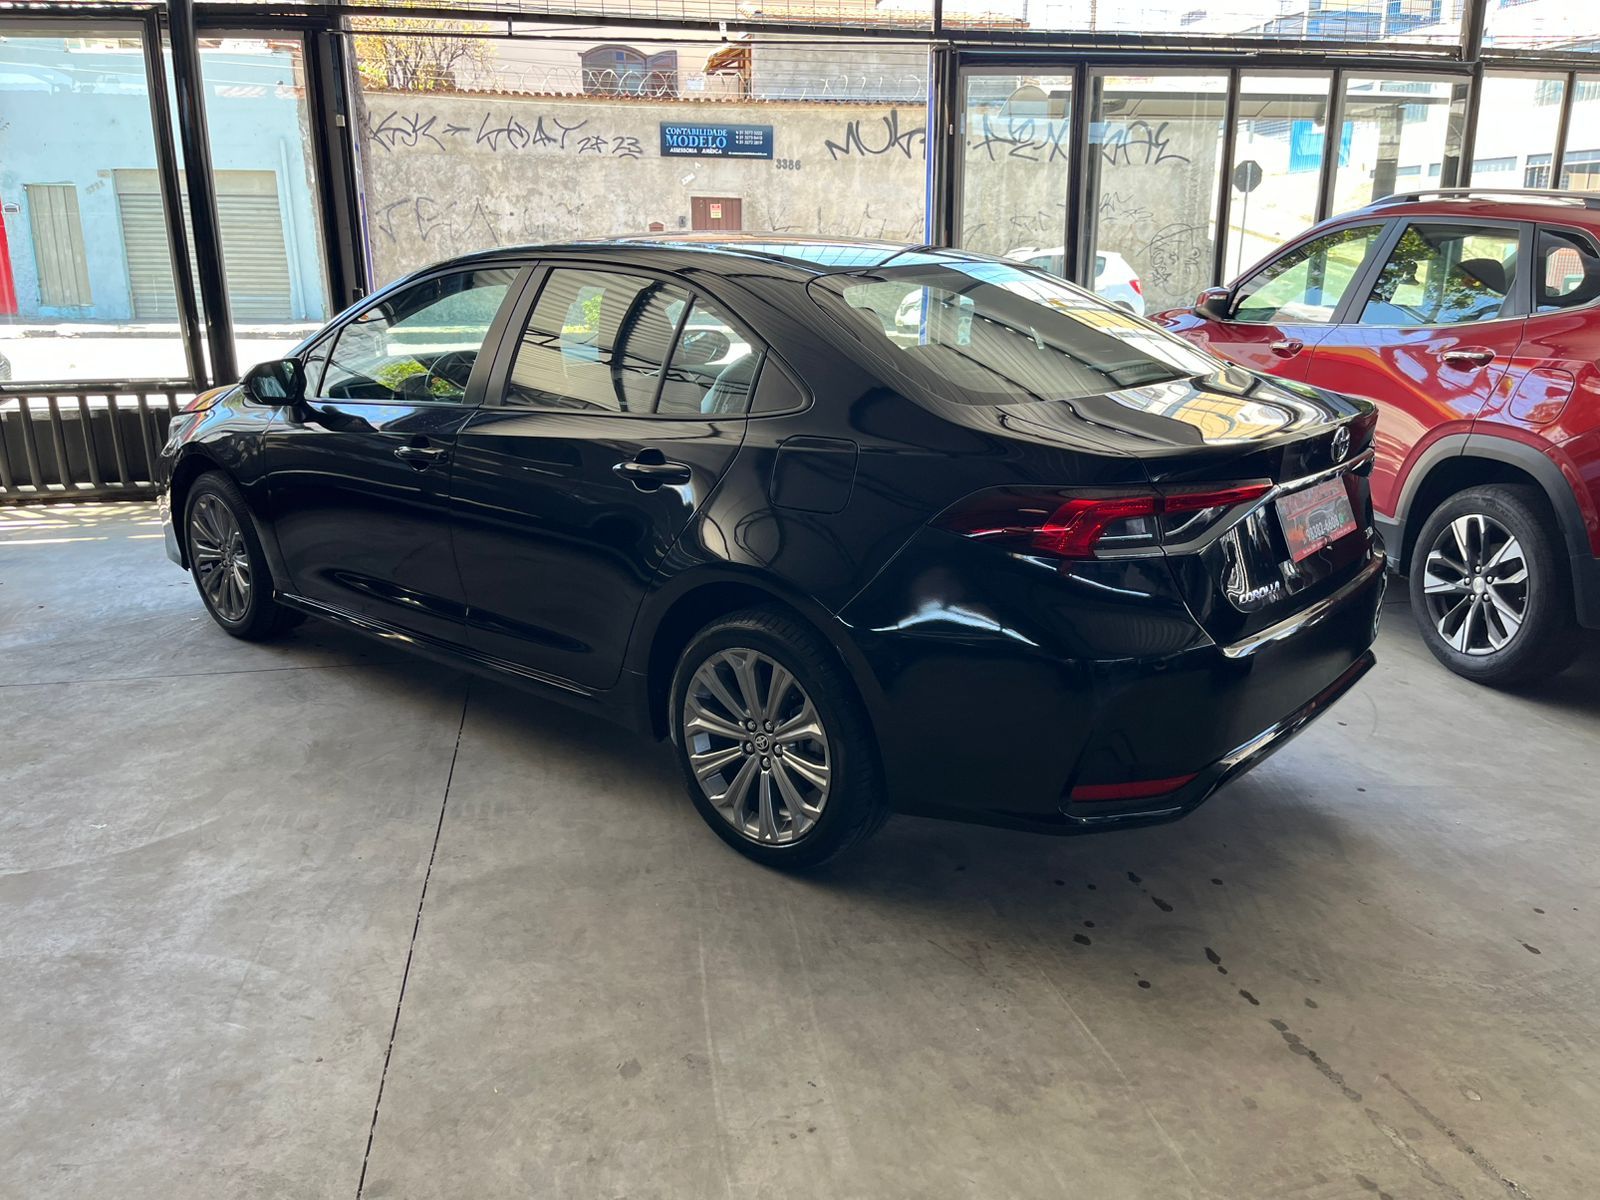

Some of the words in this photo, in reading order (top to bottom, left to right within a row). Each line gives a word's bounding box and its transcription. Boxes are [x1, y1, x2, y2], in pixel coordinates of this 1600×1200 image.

[666, 127, 728, 136] CONTABILIDADE
[666, 135, 727, 148] MODELO
[776, 159, 801, 171] 3386
[1239, 581, 1280, 604] COROLLA
